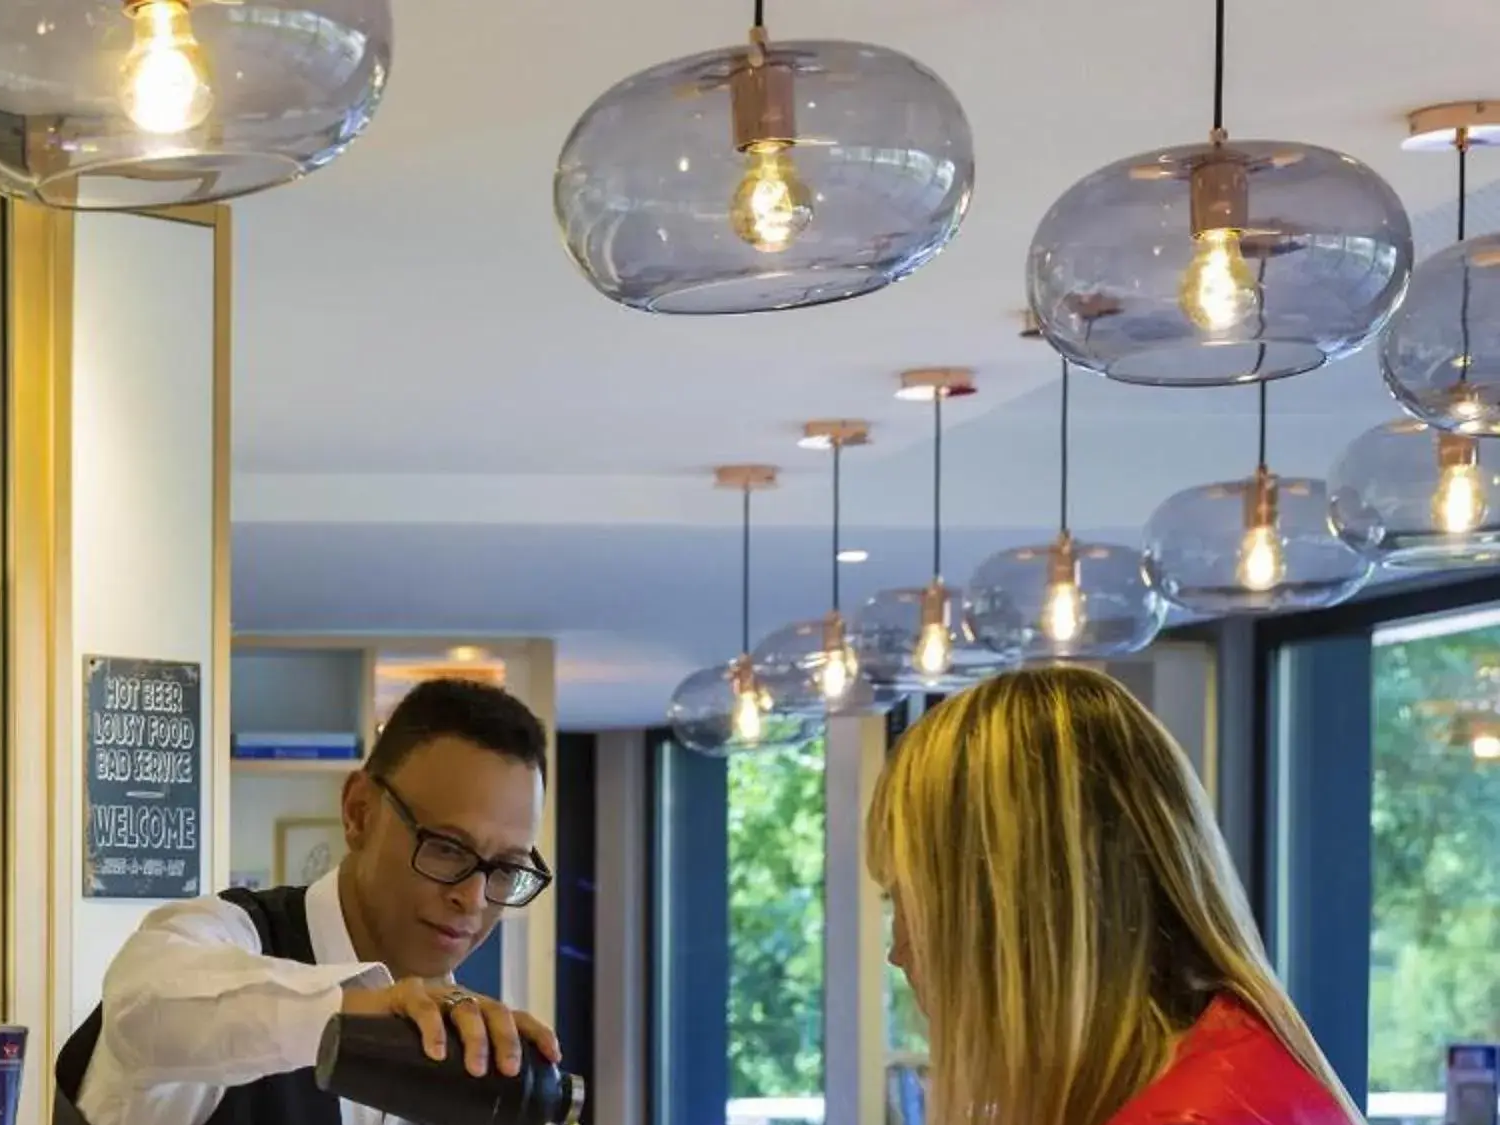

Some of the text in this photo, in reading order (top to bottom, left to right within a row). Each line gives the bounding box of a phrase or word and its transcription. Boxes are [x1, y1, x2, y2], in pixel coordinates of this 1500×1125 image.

[105, 677, 184, 713] HOT BEER
[94, 712, 195, 750] LOUSY FOOD
[96, 749, 194, 784] BAD SERVICE
[94, 804, 196, 850] WELCOME
